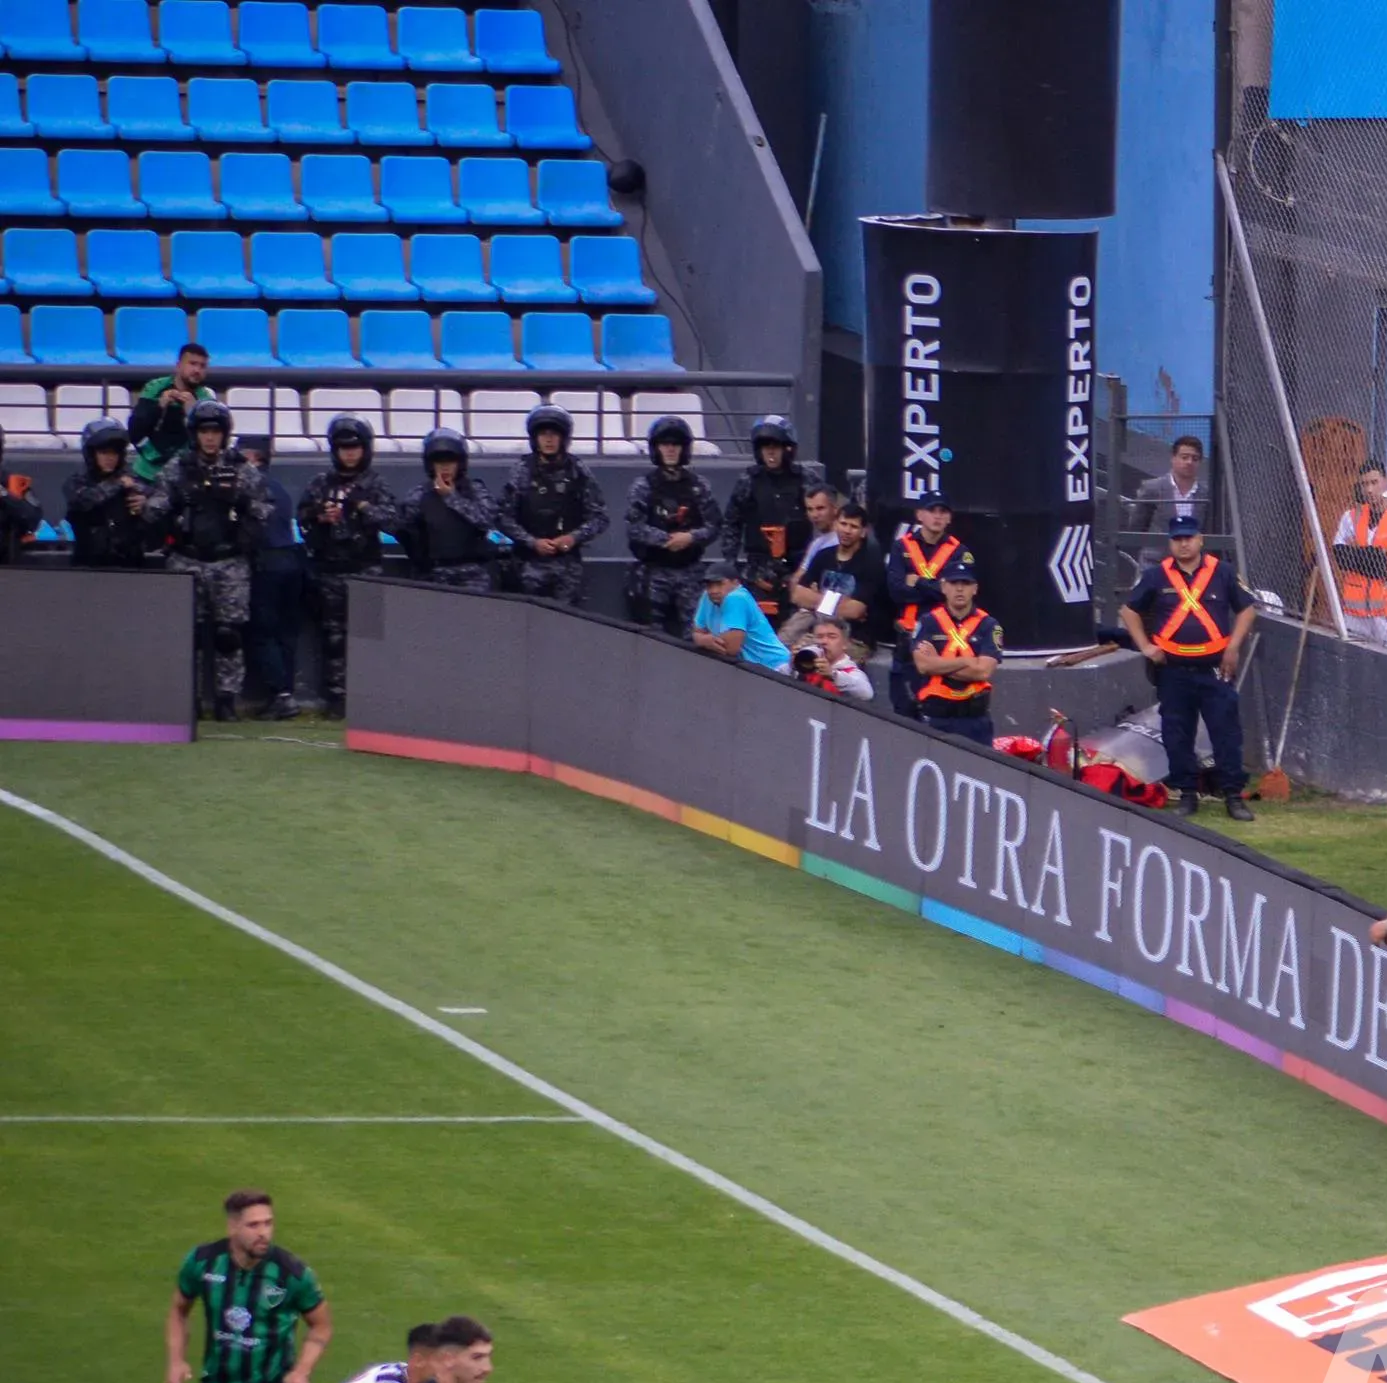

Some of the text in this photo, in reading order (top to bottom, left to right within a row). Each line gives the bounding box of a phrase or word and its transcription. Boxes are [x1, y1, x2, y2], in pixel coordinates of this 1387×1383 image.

[903, 273, 941, 500] EXPERTO
[1066, 276, 1091, 502] EXPERTO
[805, 718, 881, 852] LA
[906, 758, 1072, 927] OTRA
[1095, 826, 1306, 1031] FORMA
